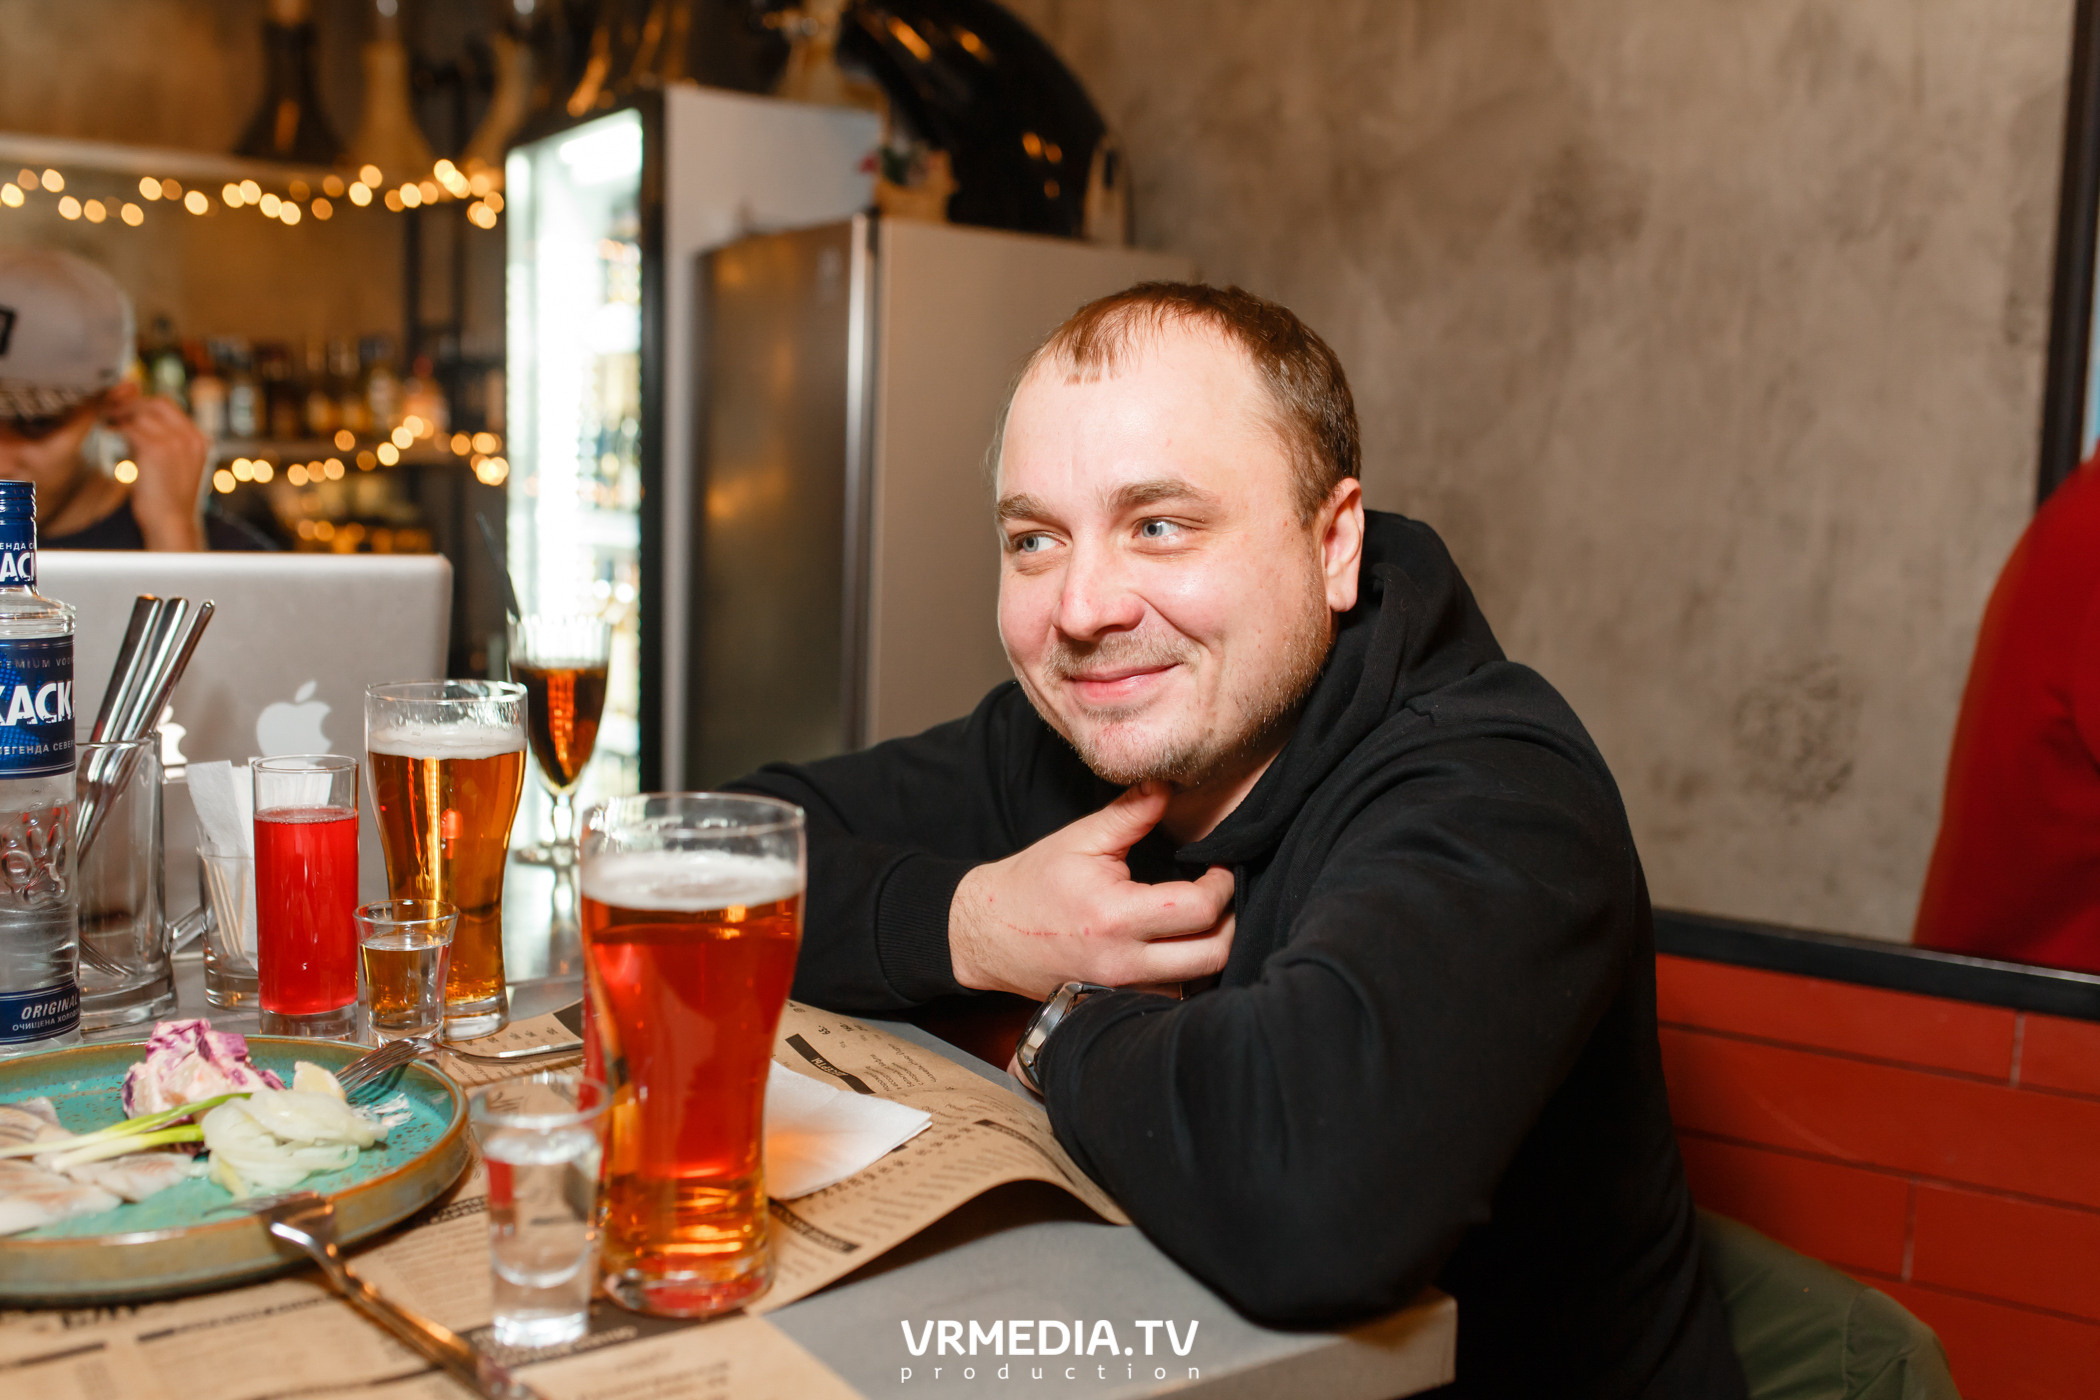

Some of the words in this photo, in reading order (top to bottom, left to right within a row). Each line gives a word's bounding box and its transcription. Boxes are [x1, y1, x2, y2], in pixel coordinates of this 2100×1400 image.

[0, 542, 26, 551] ЕНДА
[0, 552, 35, 582] АС
[21, 993, 78, 1020] ORIGINAL
[12, 1019, 56, 1031] ОЧИЩЕНА
